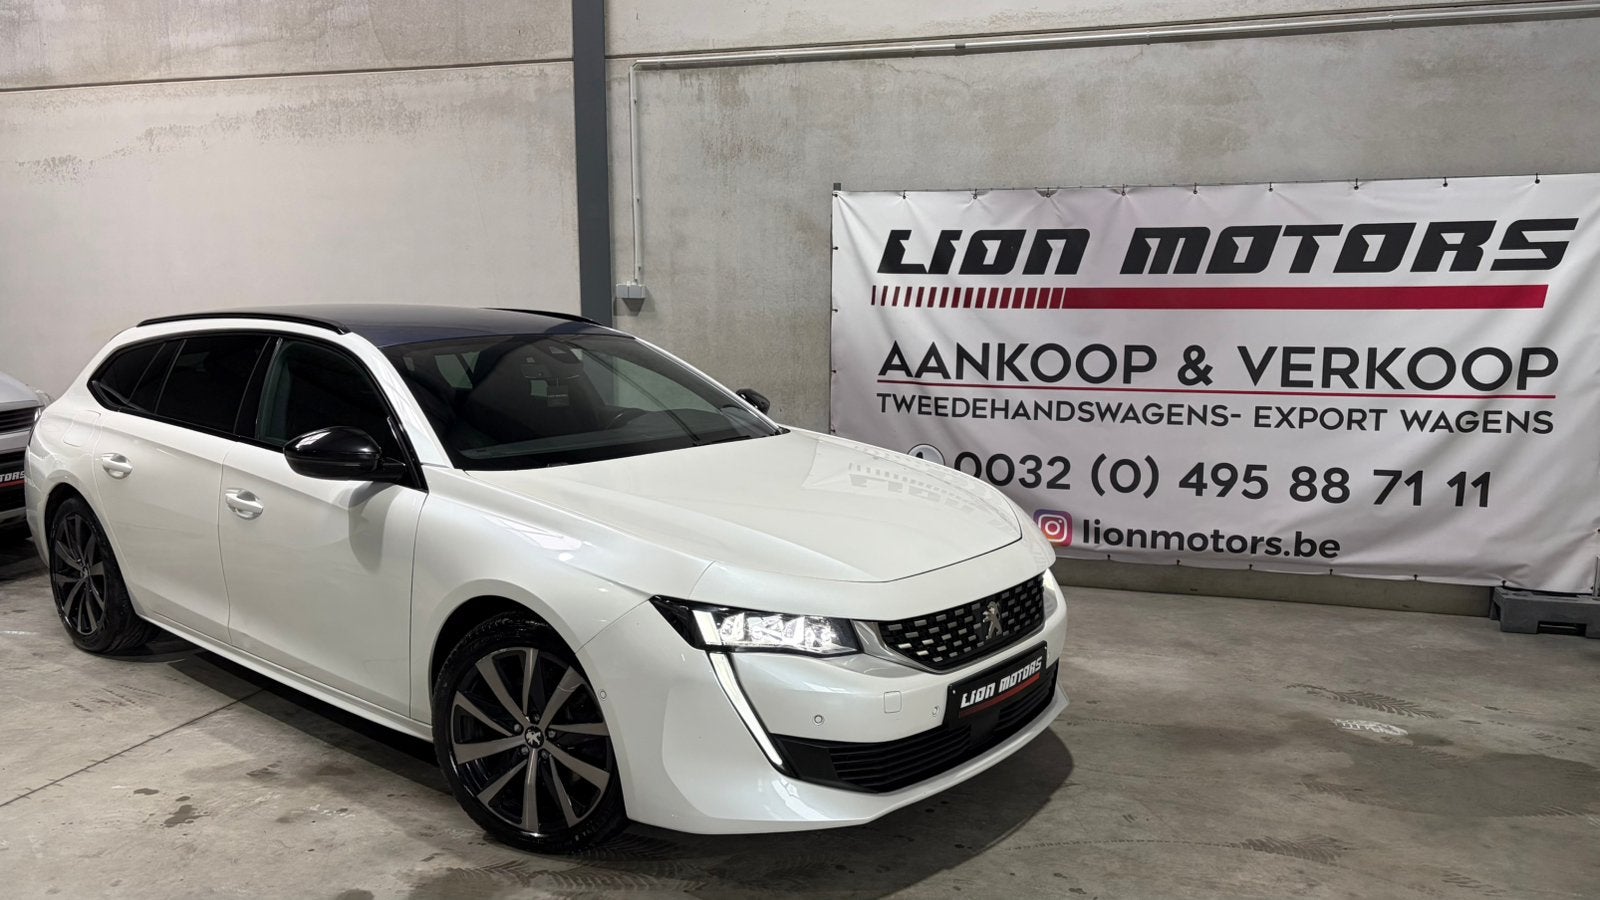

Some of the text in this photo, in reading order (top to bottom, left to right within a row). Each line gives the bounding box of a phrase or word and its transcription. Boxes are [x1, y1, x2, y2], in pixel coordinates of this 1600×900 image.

[877, 217, 1580, 275] LION MOTORS
[876, 341, 1559, 391] AANKOOP & VERKOOP
[876, 393, 1554, 435] TWEEDEHANDSWAGENS- EXPORT WAGENS
[953, 451, 1491, 508] 0032 (0) 495 88 71 11
[1082, 518, 1341, 559] lionmotors.be
[960, 655, 1042, 708] LION MOTORS
